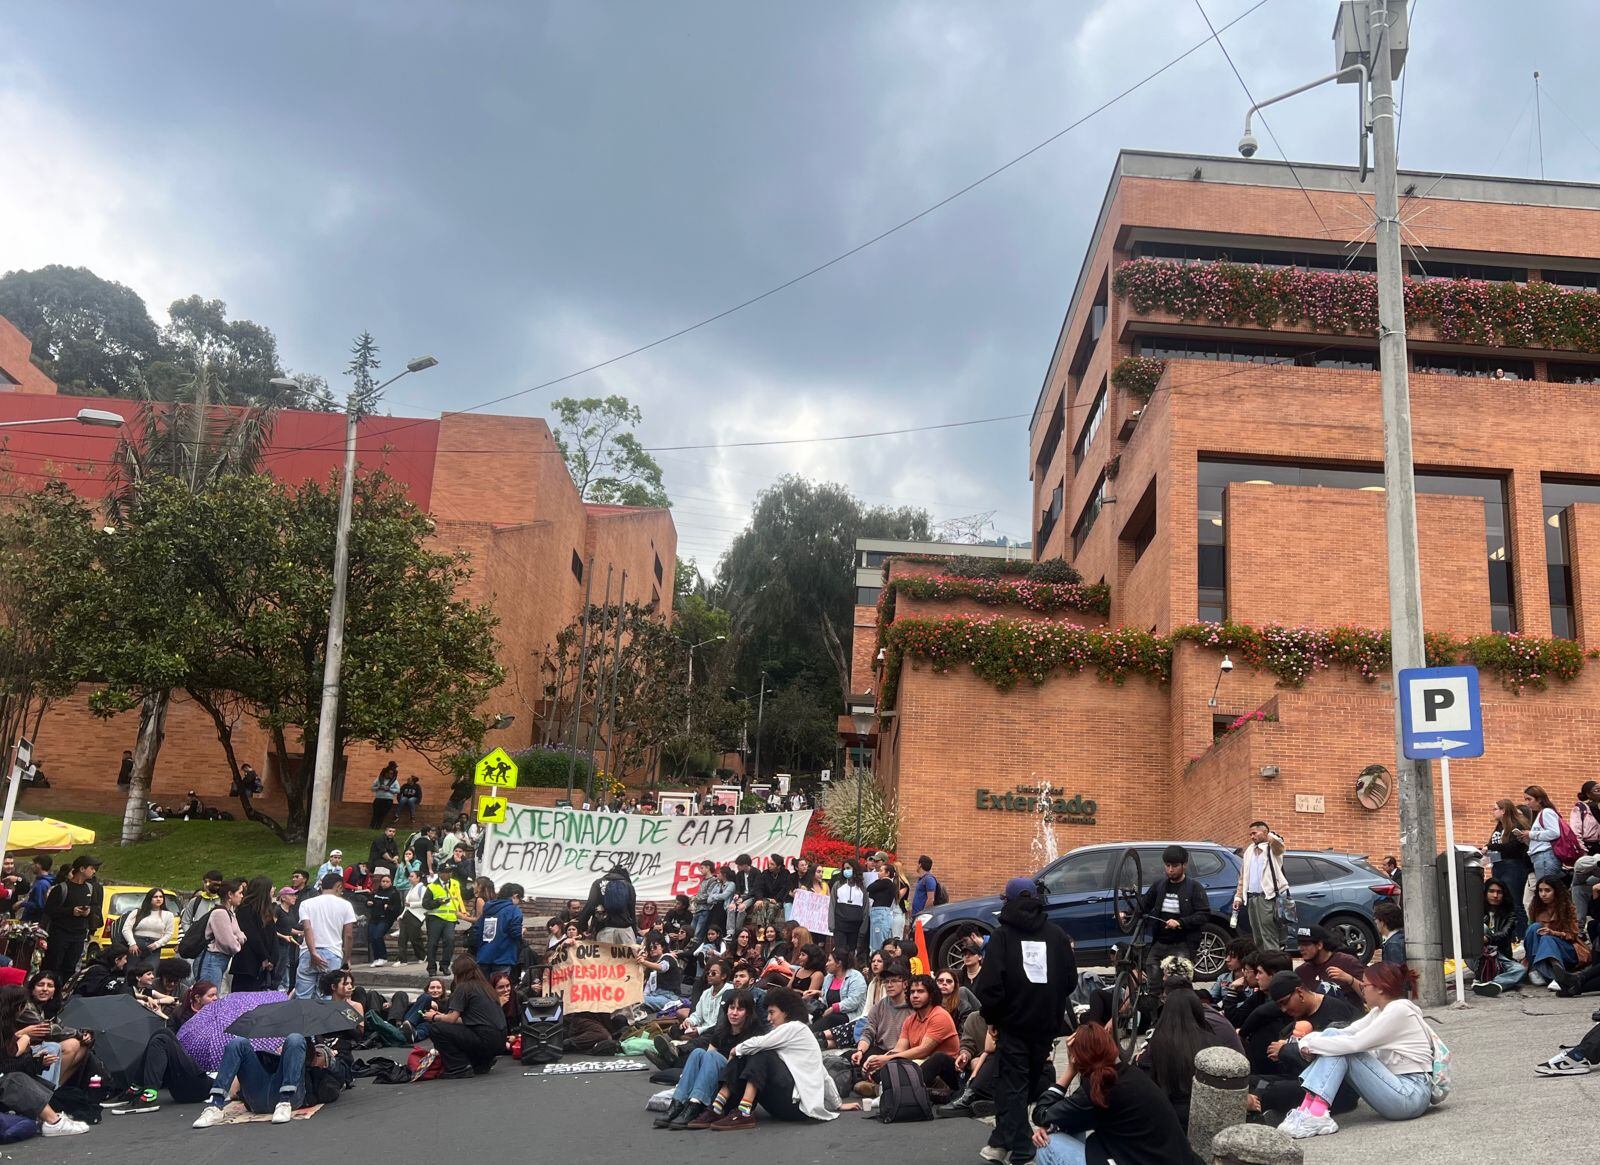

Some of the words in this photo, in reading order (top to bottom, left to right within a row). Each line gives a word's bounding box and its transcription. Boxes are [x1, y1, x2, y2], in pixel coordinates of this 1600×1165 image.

[1423, 688, 1455, 722] P
[1017, 785, 1064, 795] Univedad
[638, 818, 671, 845] DE
[677, 817, 750, 846] CARA
[767, 814, 798, 839] AL
[490, 840, 561, 873] CERRO
[564, 847, 588, 870] DE
[591, 850, 660, 876] ESPALDA
[576, 944, 600, 960] QUE
[611, 946, 635, 959] UNA
[570, 984, 625, 1003] BANCO
